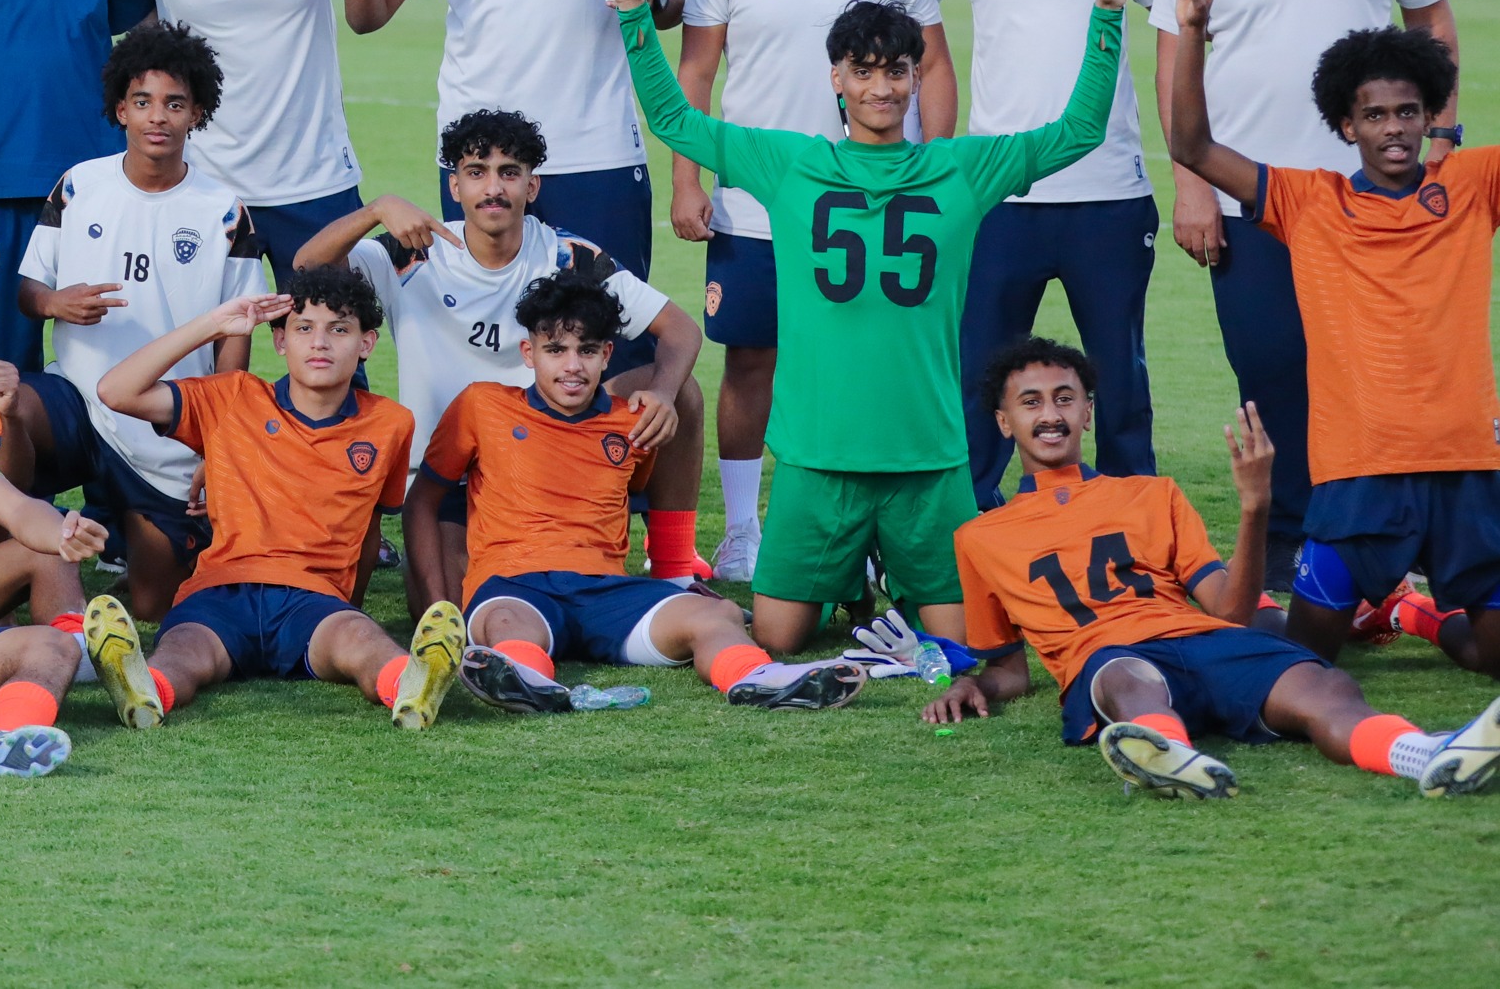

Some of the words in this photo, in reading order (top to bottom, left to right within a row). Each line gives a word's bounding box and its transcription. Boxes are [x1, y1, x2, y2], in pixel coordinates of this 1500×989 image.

[123, 251, 150, 283] 18
[811, 190, 940, 309] 55
[467, 321, 501, 353] 24
[1029, 531, 1156, 629] 14
